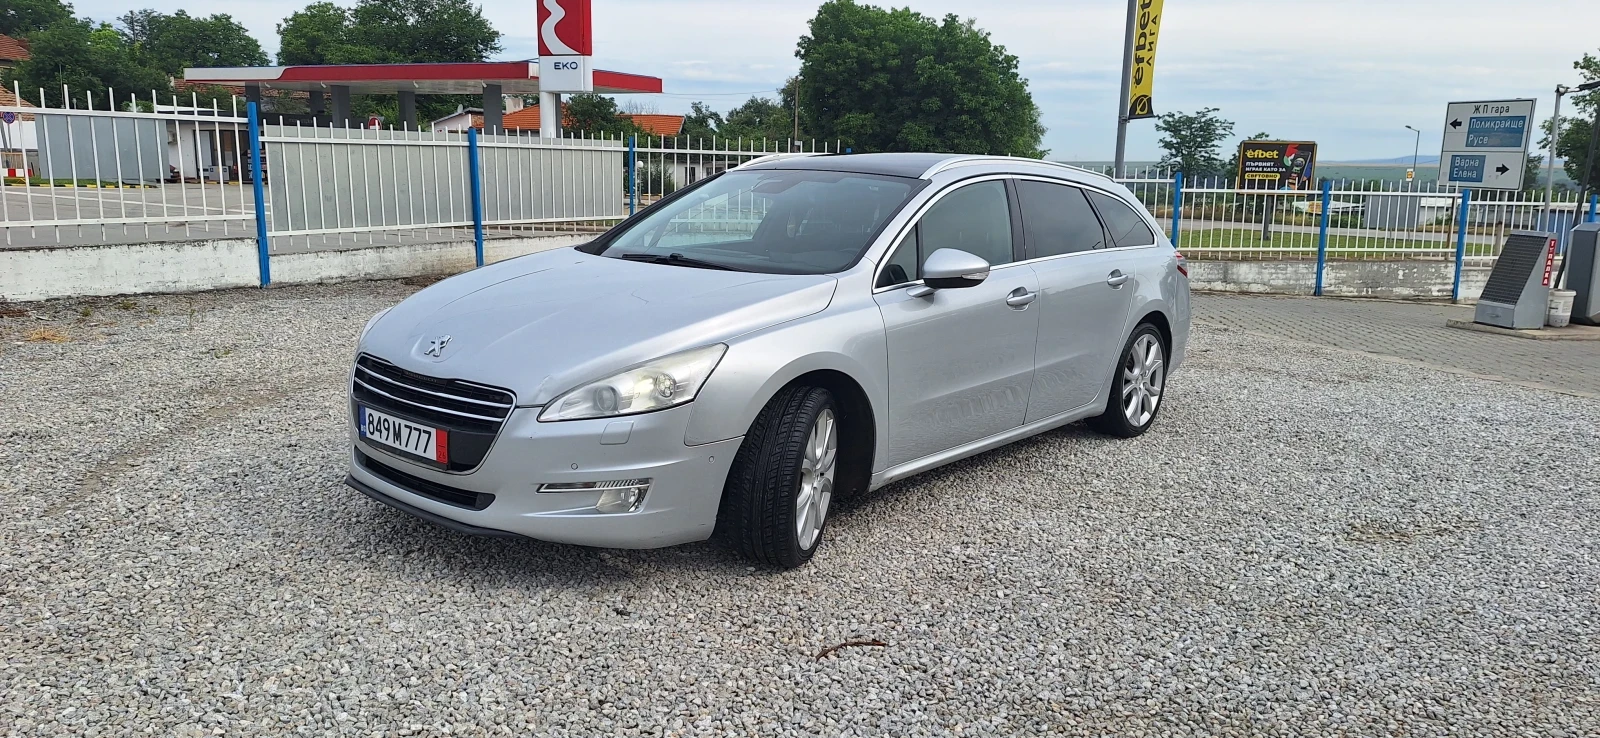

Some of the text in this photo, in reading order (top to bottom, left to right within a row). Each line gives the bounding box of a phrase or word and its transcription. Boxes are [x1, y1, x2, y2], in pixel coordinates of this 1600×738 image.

[1146, 14, 1158, 67] ЛИГА
[553, 61, 579, 70] EKO
[1491, 105, 1510, 116] гара
[1470, 118, 1524, 131] Поликрайще
[1468, 134, 1489, 147] Русе
[1245, 149, 1279, 159] efbet
[1454, 156, 1480, 169] Варна
[1452, 168, 1477, 178] Елена
[368, 413, 432, 453] 849M777
